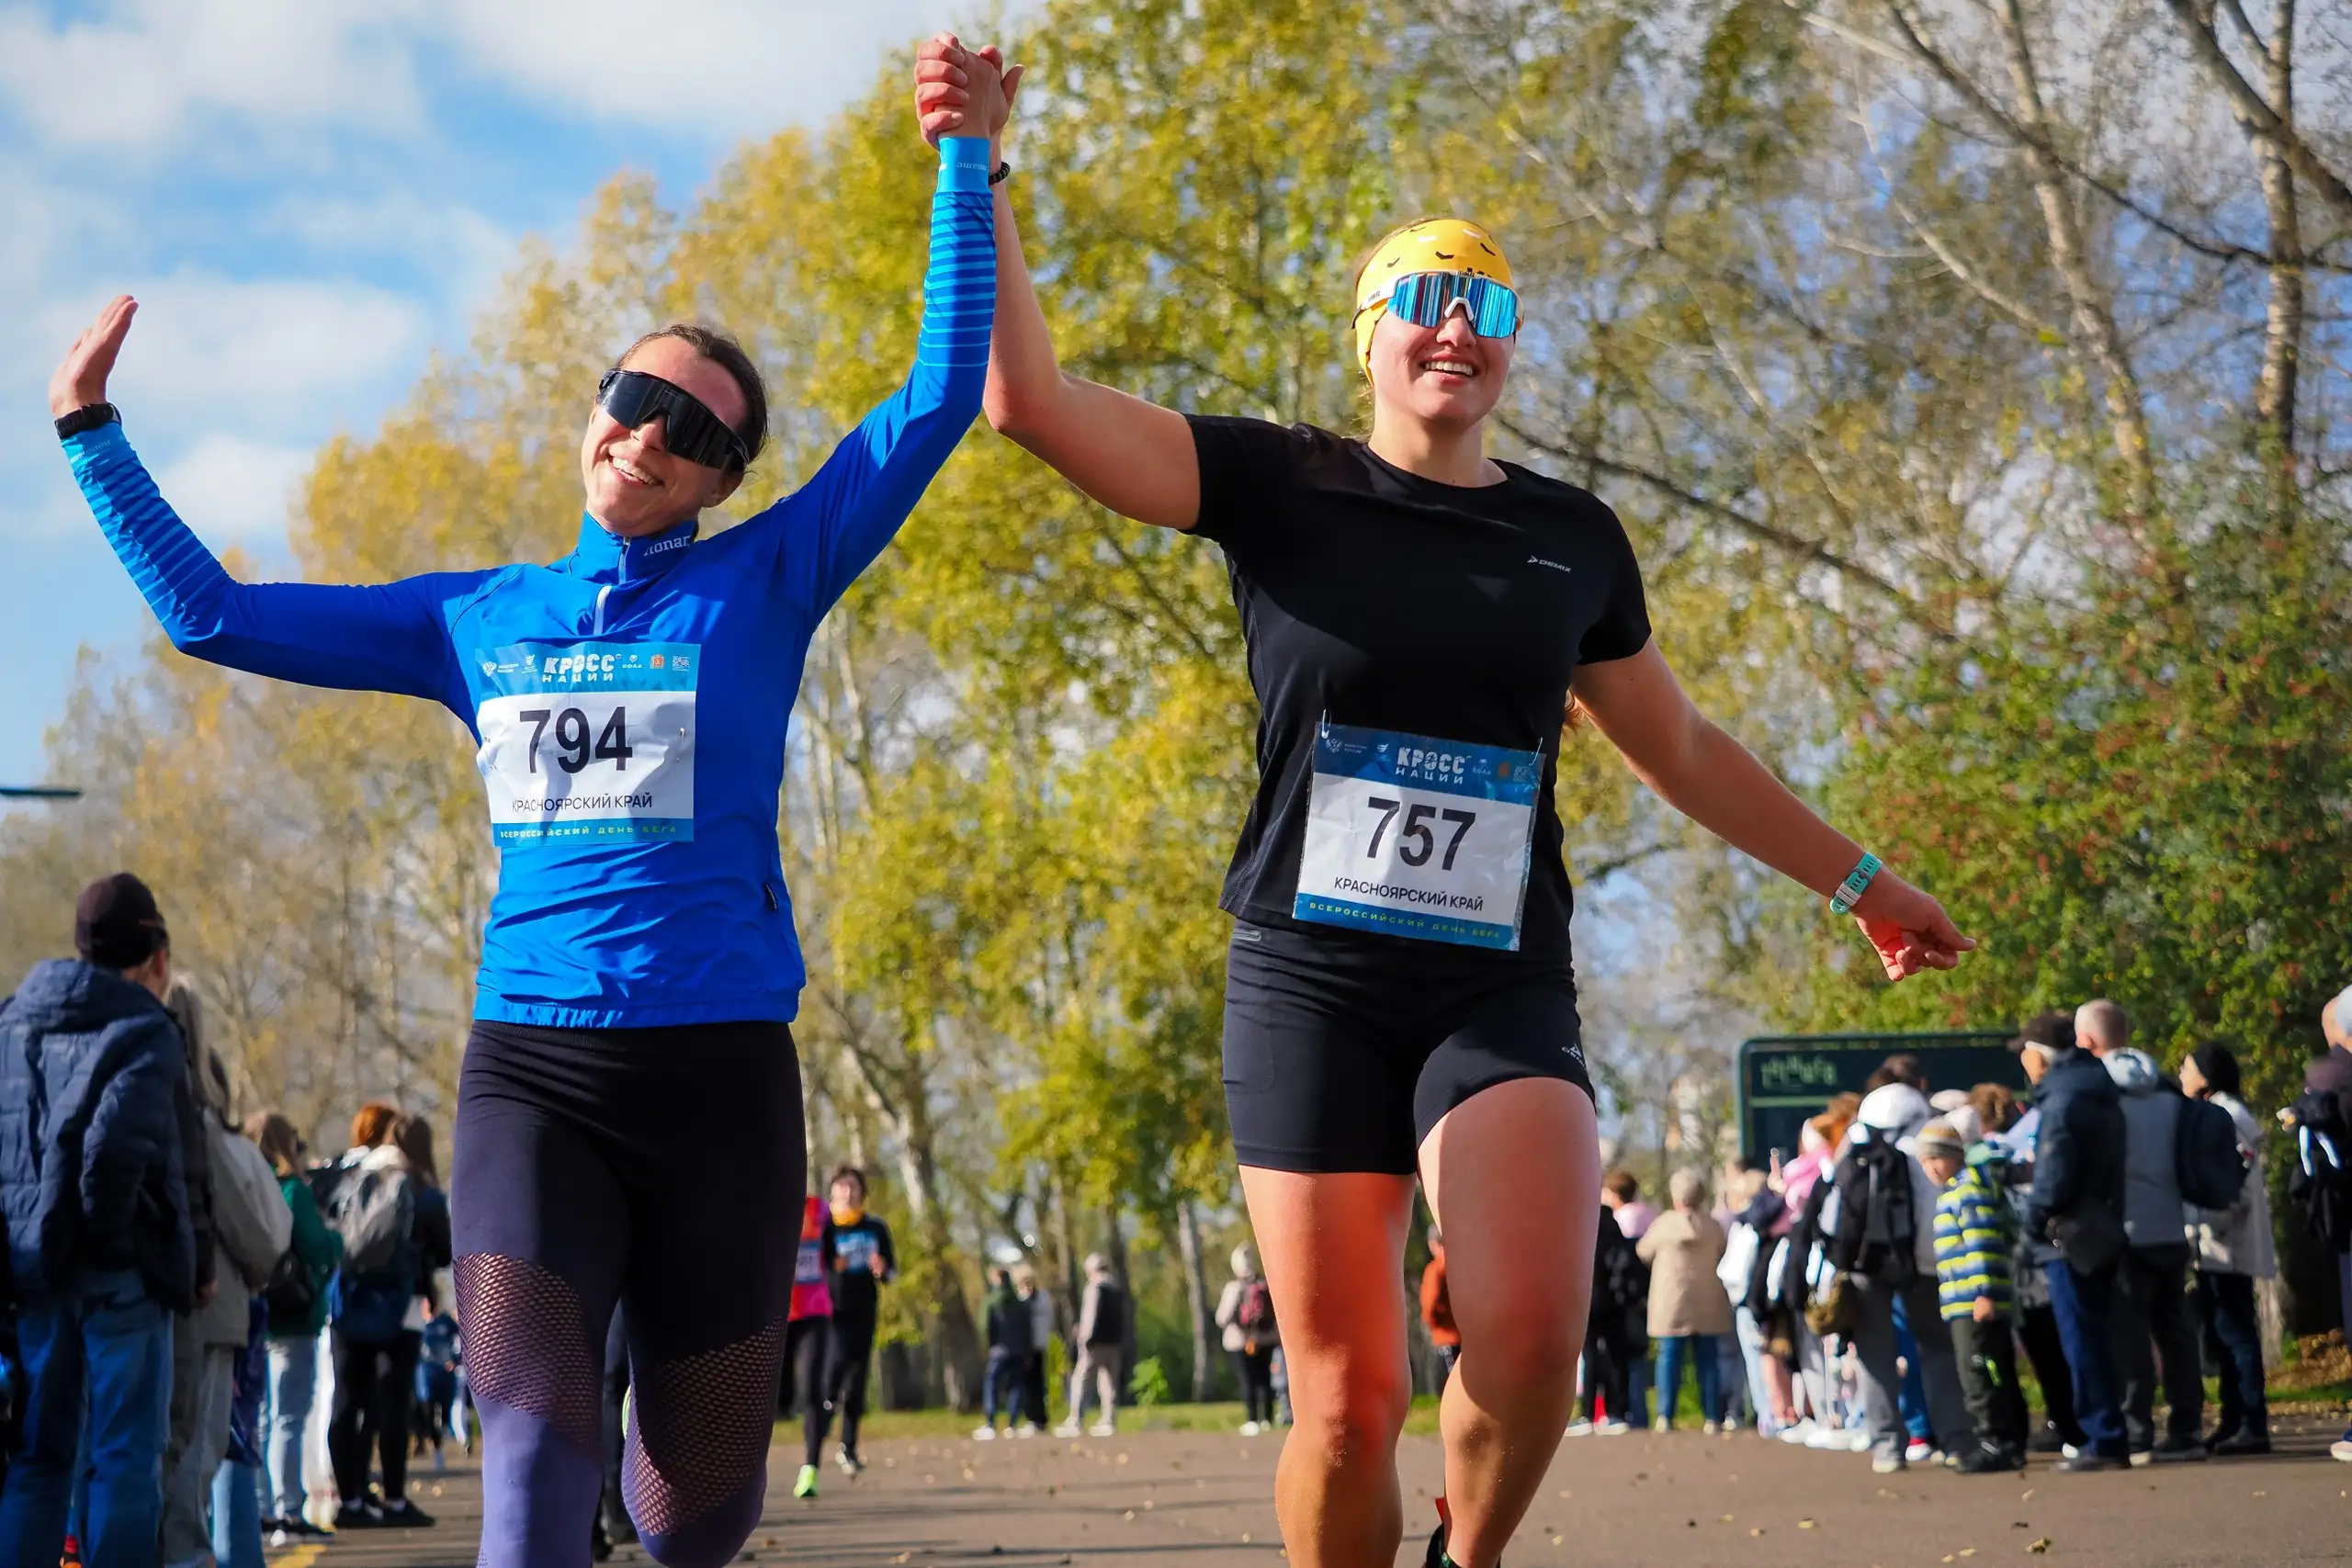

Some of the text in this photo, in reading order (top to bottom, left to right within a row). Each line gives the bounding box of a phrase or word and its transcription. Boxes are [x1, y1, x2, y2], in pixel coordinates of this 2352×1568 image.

[1539, 558, 1572, 573] DEMIX
[543, 653, 616, 674] КРОСС
[542, 672, 614, 682] НАЦИИ
[519, 705, 633, 774] 794
[1396, 747, 1465, 774] КРОСС
[1396, 766, 1464, 784] НАЦИИ
[512, 792, 653, 813] КРАСНОЯРСКИЙ КРАЙ
[500, 826, 591, 838] ВСЕРОССИЙСКИЙ
[1366, 795, 1476, 872] 757
[1334, 876, 1484, 911] КРАСНОЯРСКИЙ КРАЙ
[1309, 902, 1500, 939] ВСЕРОССИЙСКИЙ ДЕНЬ БЕГА
